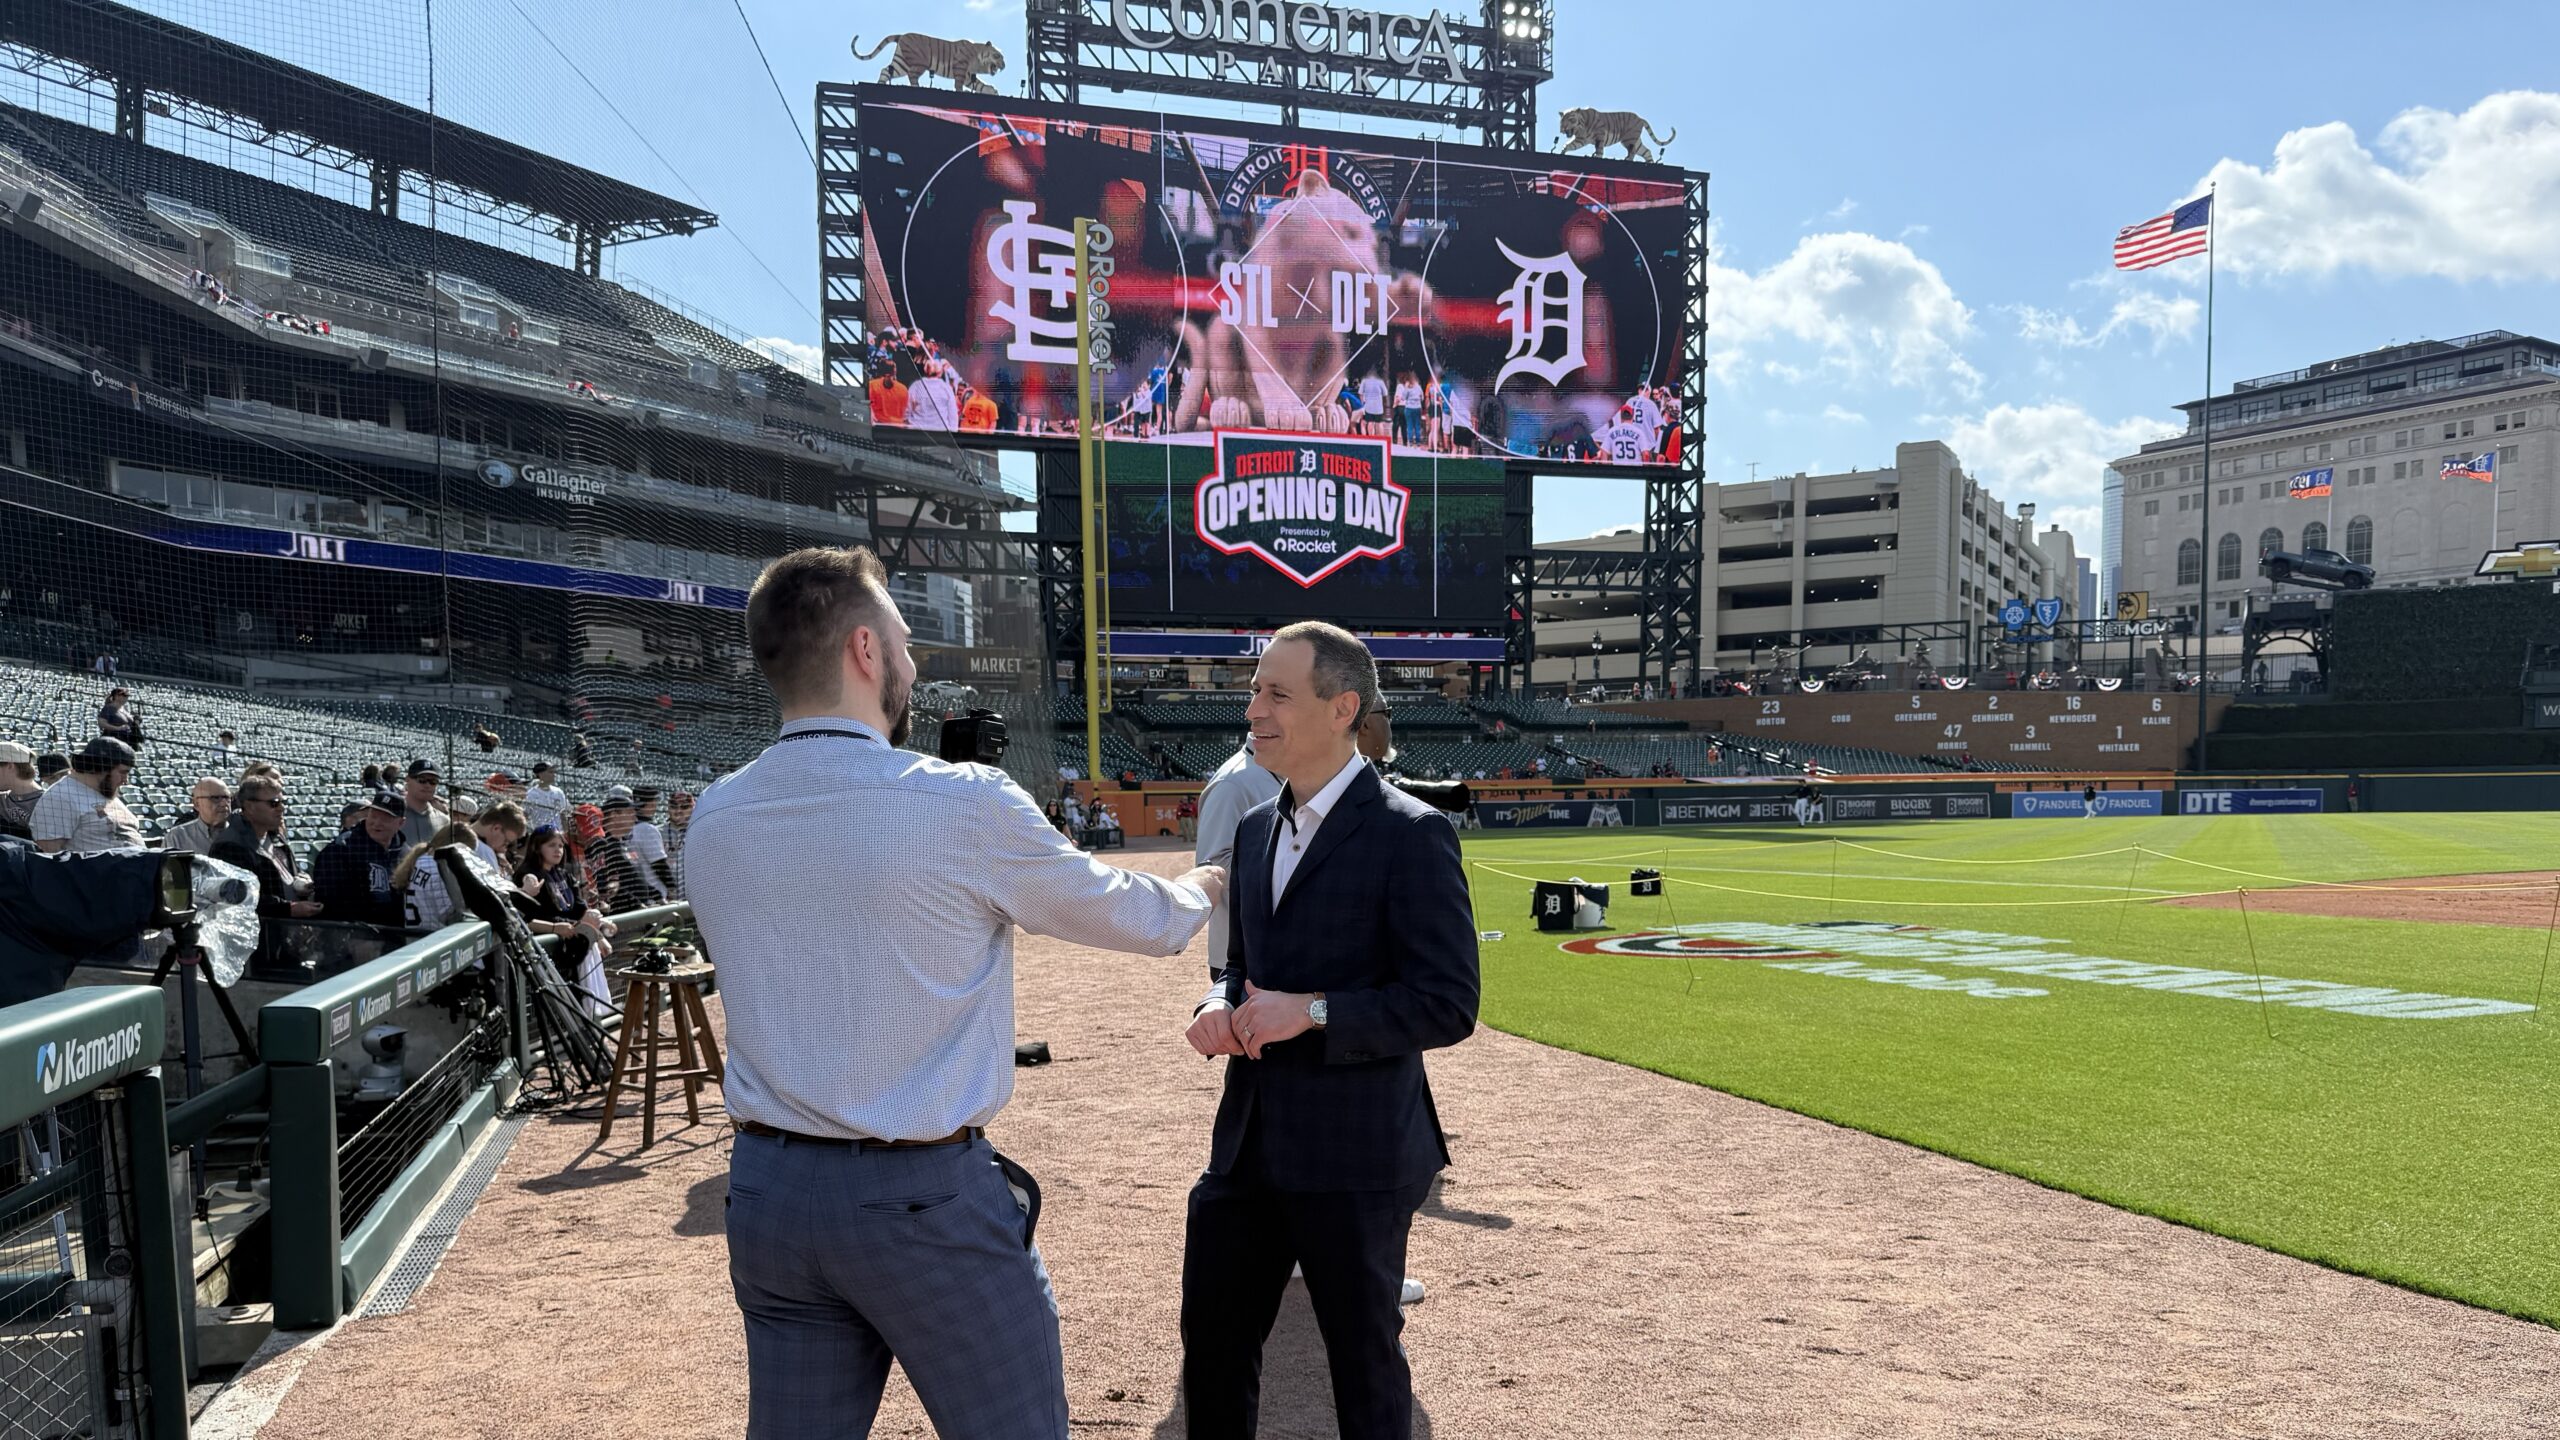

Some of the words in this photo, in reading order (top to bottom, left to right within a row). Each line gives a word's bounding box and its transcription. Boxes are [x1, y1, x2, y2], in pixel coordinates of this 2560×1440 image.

[1216, 50, 1376, 94] PARK
[1226, 147, 1283, 208] DETROIT
[1335, 157, 1387, 221] TIGERS
[1220, 262, 1279, 328] STL
[1331, 271, 1392, 336] DET
[1495, 237, 1587, 396] D
[1615, 441, 1636, 460] 35
[1236, 451, 1296, 478] DETROIT
[1322, 453, 1372, 483] TIGERS
[521, 464, 607, 495] Gallagher
[536, 487, 595, 506] INSURANCE
[1207, 476, 1337, 531] OPENING
[1344, 482, 1399, 537] DAY
[1280, 526, 1321, 537] Presented
[1322, 528, 1331, 538] by
[1288, 538, 1337, 553] Rocket
[333, 613, 368, 630] ARKET
[970, 656, 1023, 673] MARKET
[1397, 666, 1434, 679] ISTRO
[1762, 701, 1780, 714] 23
[1912, 695, 1920, 708] 5
[1988, 695, 1998, 710] 2
[2066, 696, 2081, 710] 16
[2152, 697, 2162, 712] 6
[2142, 716, 2171, 725] KALINE
[1944, 724, 1962, 738] 47
[2026, 725, 2035, 739] 3
[2116, 725, 2123, 739] 1
[1937, 741, 1968, 750] MORRIS
[2009, 742, 2051, 751] TRAMMELL
[2098, 743, 2140, 752] WHITAKER
[1848, 800, 1876, 808] BIGGBY
[1957, 798, 1983, 806] BIGGBY
[2039, 799, 2082, 810] FANDUEL
[2109, 799, 2152, 808] FANDUEL
[2186, 792, 2232, 813] DTE
[1549, 809, 1570, 819] TIME
[1678, 804, 1741, 819] BETMGM
[1848, 808, 1876, 817] COFFEE
[1957, 806, 1984, 814] COFFEE
[1762, 961, 2050, 998] Adobe
[1918, 948, 2539, 1018] WEEKEND
[65, 1022, 142, 1086] Karmanos
